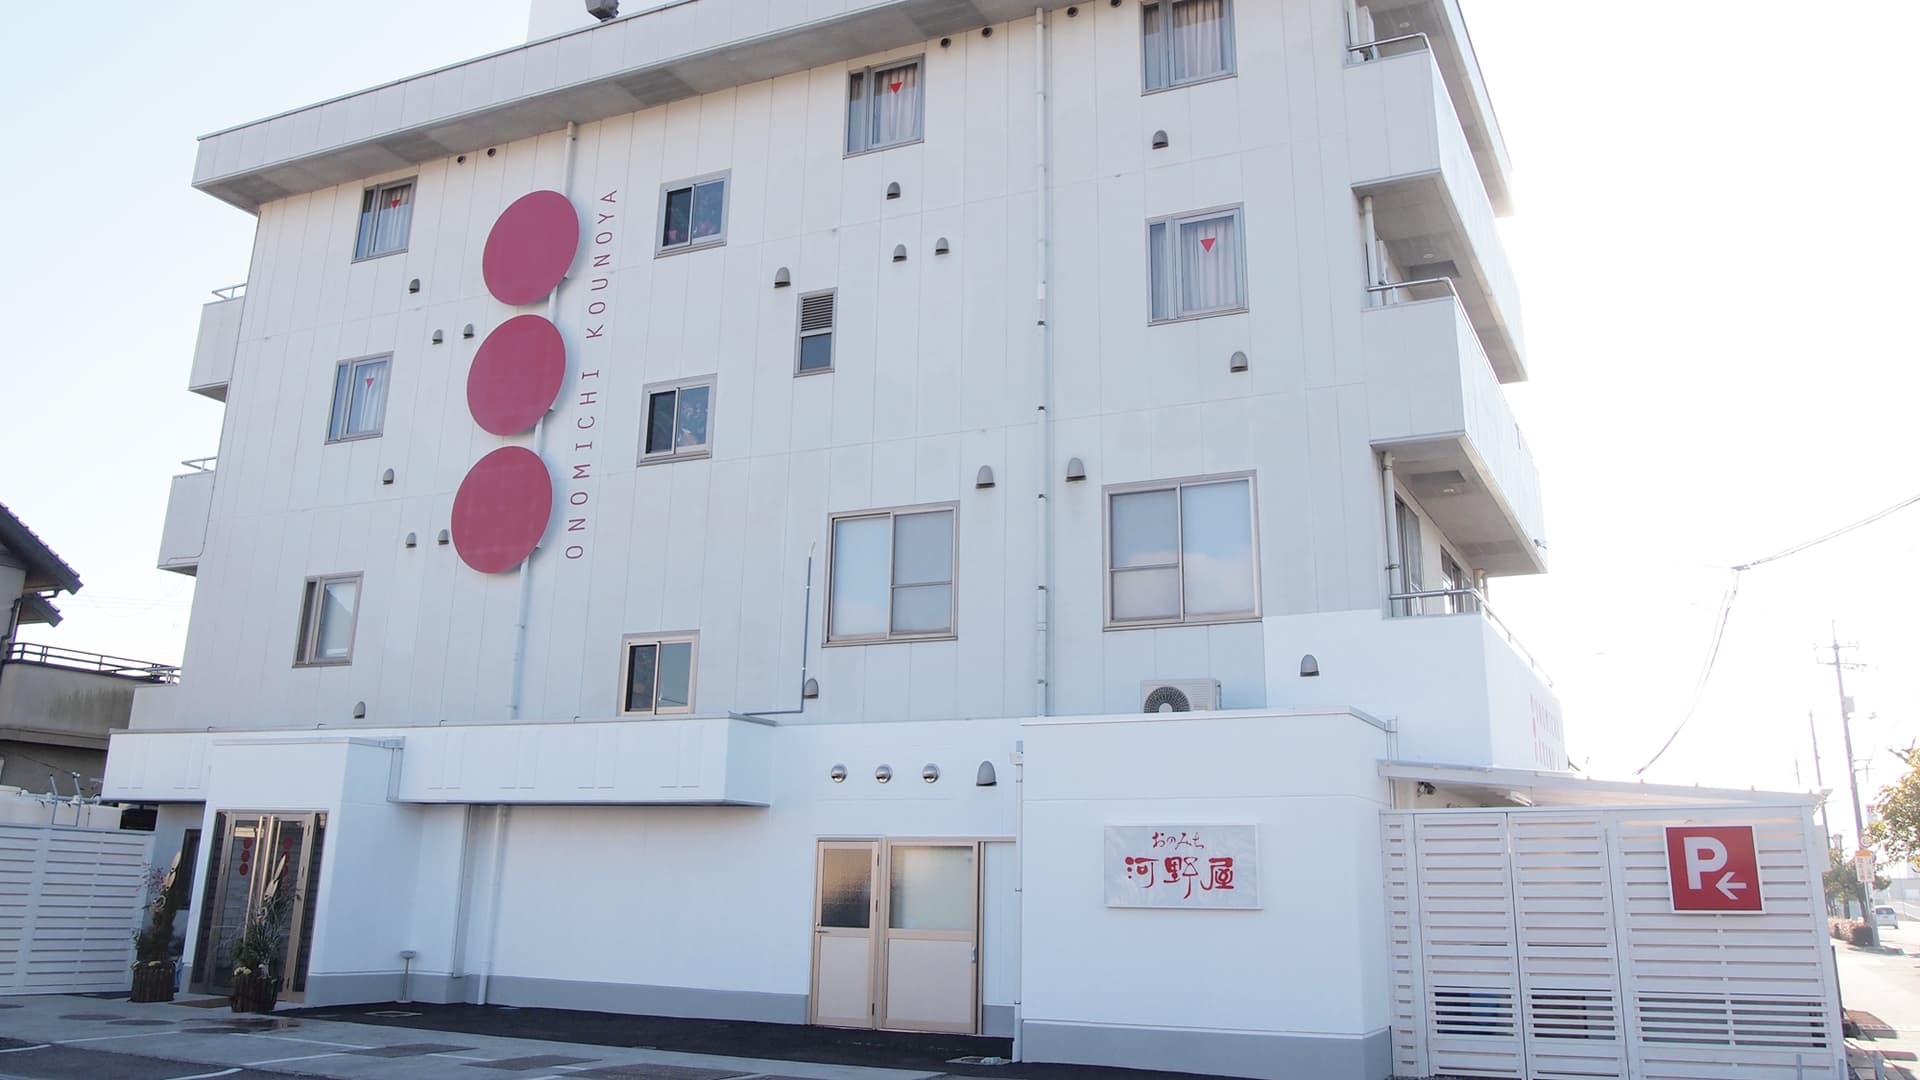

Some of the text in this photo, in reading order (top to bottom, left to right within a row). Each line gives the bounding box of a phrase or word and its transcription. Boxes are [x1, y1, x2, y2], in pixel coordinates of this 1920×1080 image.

[565, 190, 618, 560] ONOMICHI KOUNOYA
[1152, 831, 1205, 849] おのみち
[1683, 836, 1728, 890] P
[1125, 856, 1235, 899] 河野屋
